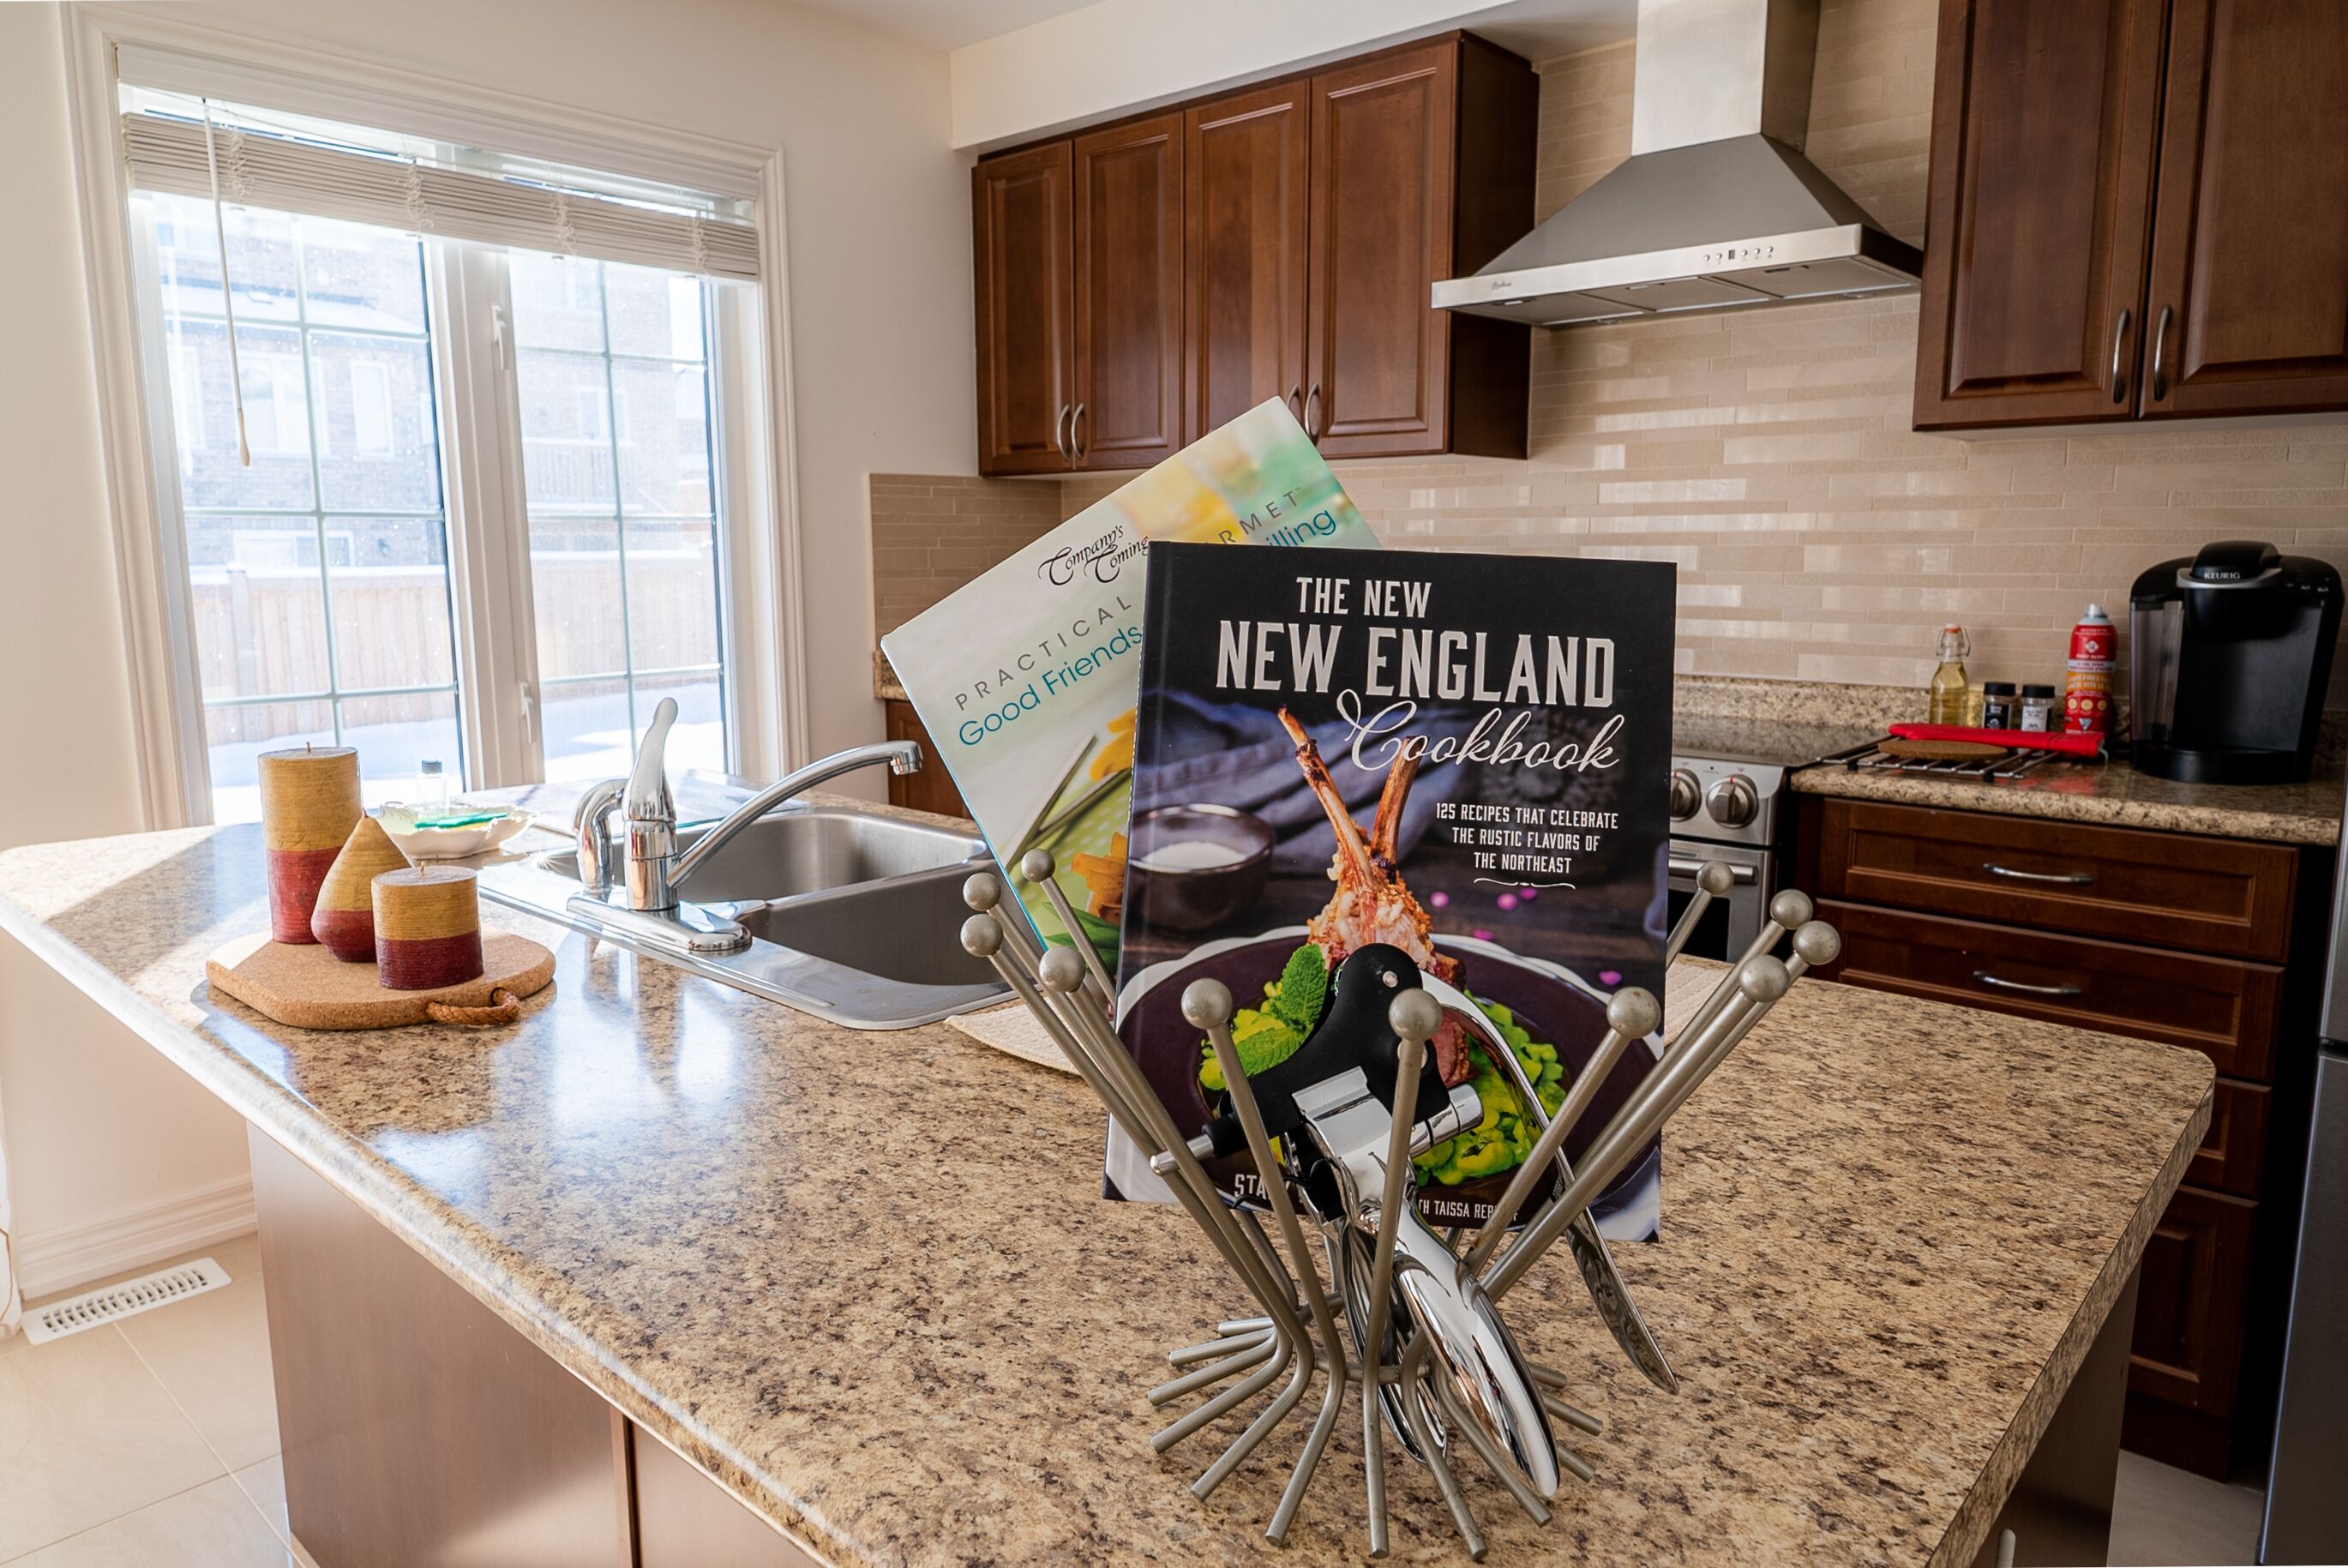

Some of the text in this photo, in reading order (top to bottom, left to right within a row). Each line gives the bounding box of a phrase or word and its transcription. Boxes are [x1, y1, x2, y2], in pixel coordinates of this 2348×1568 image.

[1217, 490, 1297, 545] RMET
[1037, 525, 1124, 586] Company's
[1084, 536, 1149, 583] Coming
[1296, 577, 1432, 617] THE NEW
[955, 597, 1132, 711] PRACTICAL
[1216, 620, 1614, 707] NEW ENGLAND
[959, 627, 1143, 746] Good Friends
[1336, 689, 1624, 772] Cookbook
[1436, 802, 1618, 829] 125 RECIPES THAT CELEBRATE
[1452, 827, 1600, 851] THE RUSTIC FLAVORS OF
[1474, 852, 1571, 874] THE NORTHEAST
[1234, 1173, 1290, 1200] STA
[1434, 1200, 1470, 1217] TAISSA
